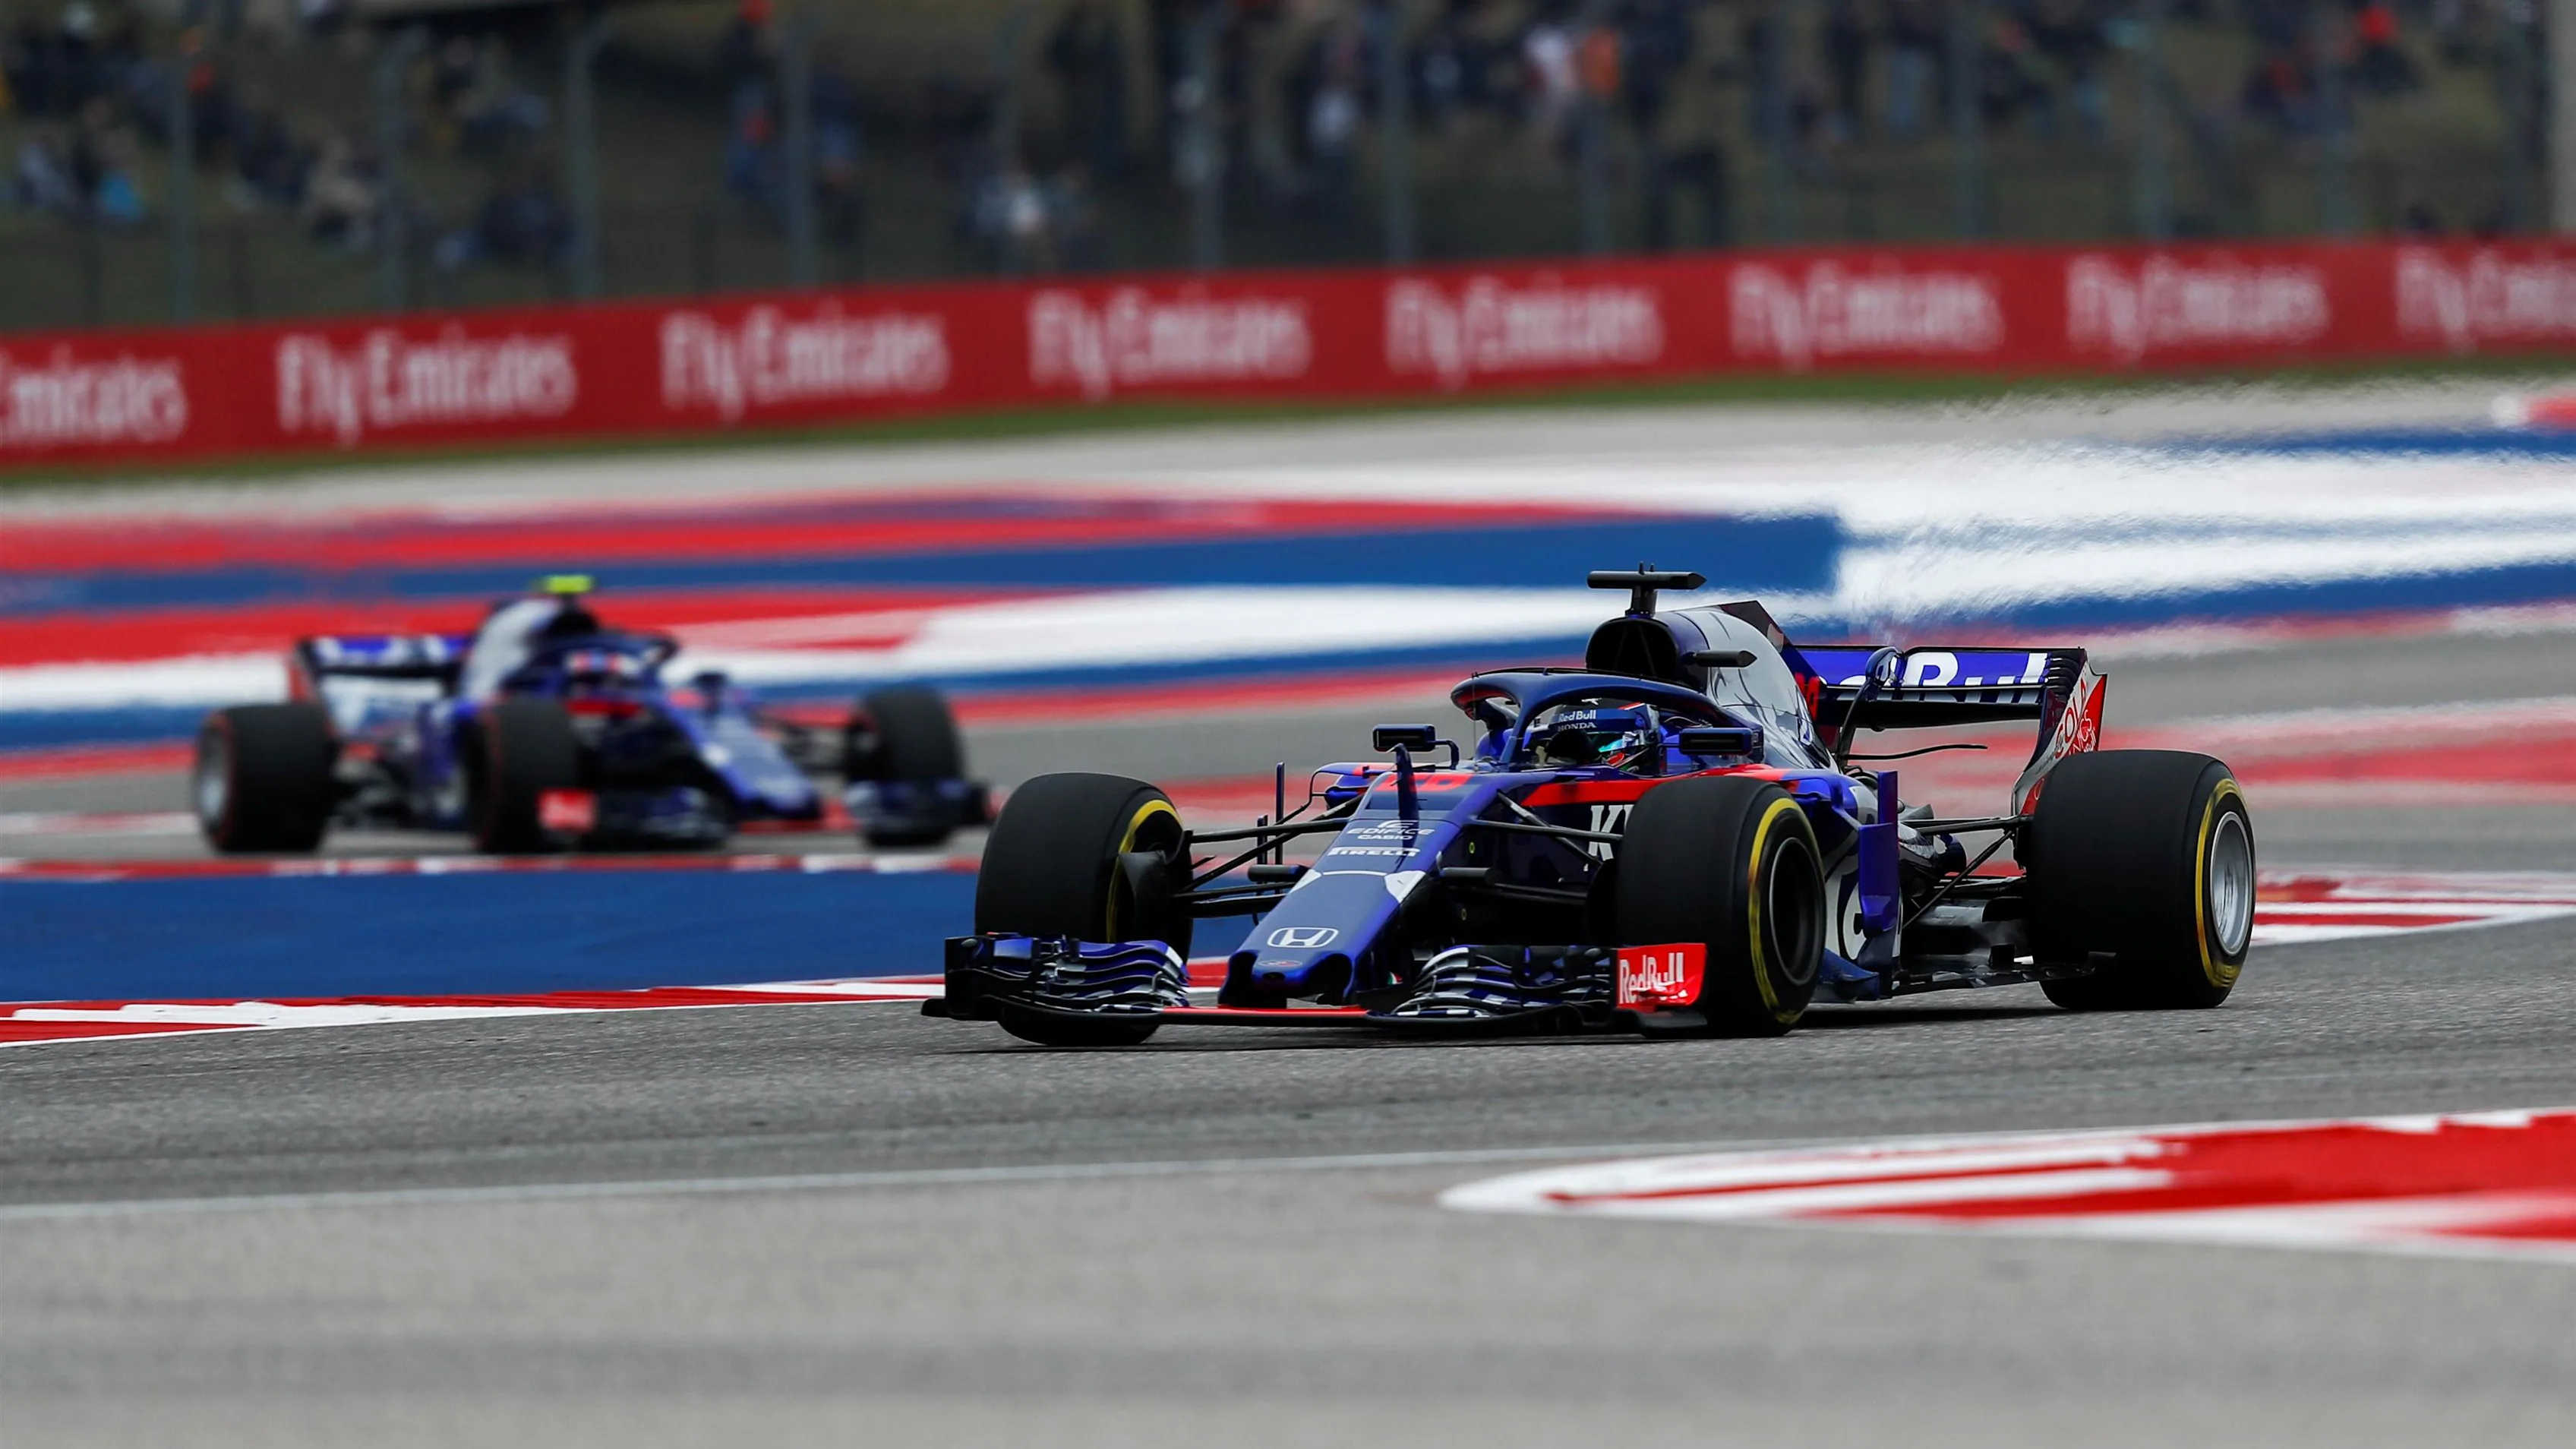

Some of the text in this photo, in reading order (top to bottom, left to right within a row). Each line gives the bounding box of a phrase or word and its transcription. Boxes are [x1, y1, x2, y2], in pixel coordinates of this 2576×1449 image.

[660, 301, 949, 421] Fly Emirates
[1028, 283, 1312, 401] Fly Emirates
[1384, 272, 1663, 390] Fly Emirates
[1728, 260, 2004, 372] Fly Emirates
[276, 327, 576, 446] Fly Emirates
[1558, 721, 1596, 732] HONDA
[1327, 847, 1421, 857] PIRELLI
